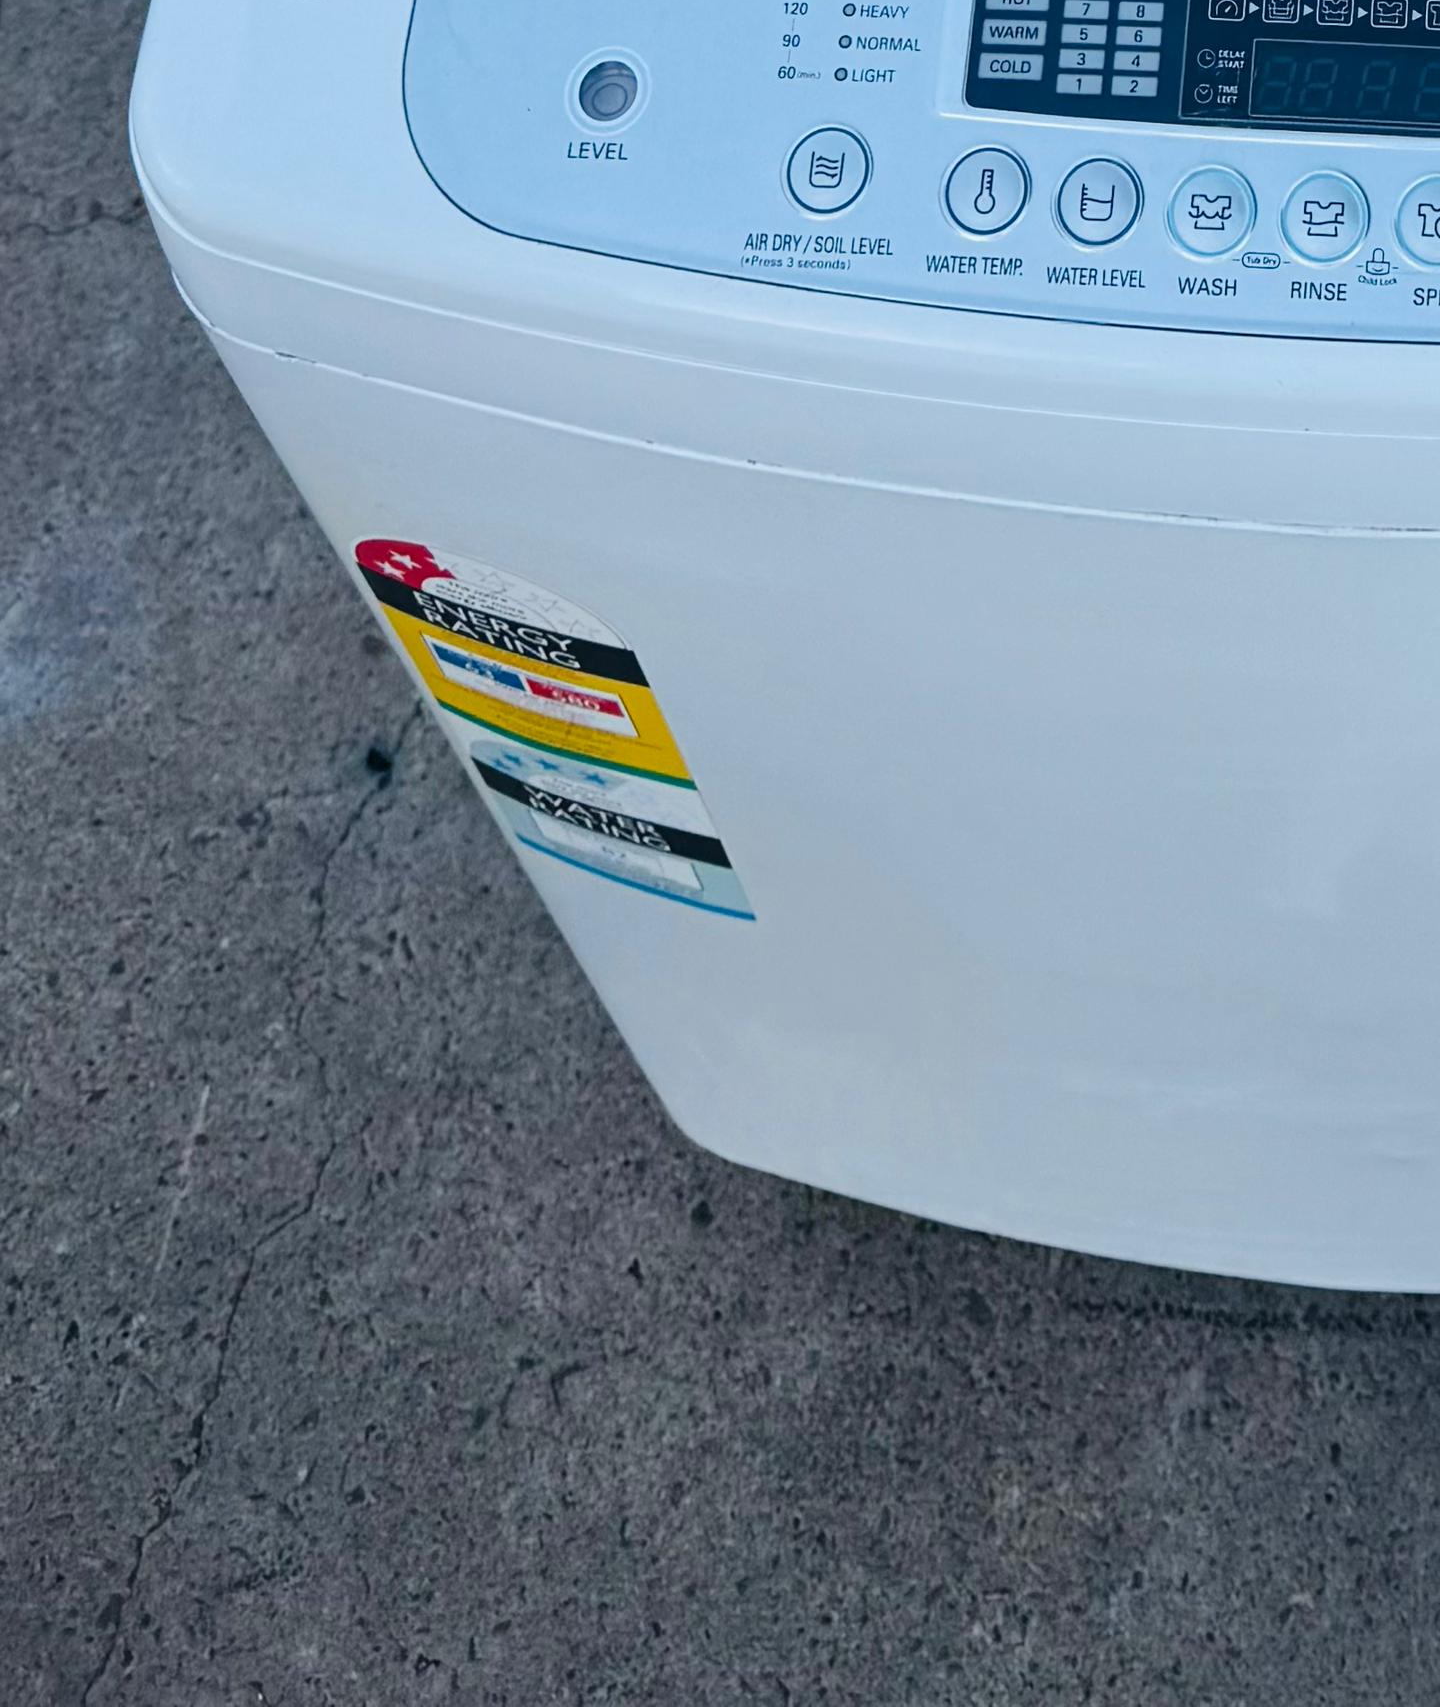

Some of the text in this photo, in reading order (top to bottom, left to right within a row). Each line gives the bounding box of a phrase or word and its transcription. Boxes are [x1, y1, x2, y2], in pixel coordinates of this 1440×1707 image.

[783, 2, 809, 16] 120
[860, 4, 909, 19] HEAVY
[1082, 3, 1091, 16] 7
[1136, 4, 1146, 18] 8
[988, 24, 1040, 41] WARM
[1079, 27, 1089, 41] 5
[1133, 29, 1143, 43] 6
[782, 34, 801, 48] 90
[855, 36, 922, 52] NORMAL
[989, 59, 1032, 74] COLD
[1076, 52, 1086, 66] 3
[1131, 54, 1141, 68] 4
[777, 65, 796, 80] 60
[851, 68, 896, 83] LIGHT
[1075, 78, 1083, 91] 1
[1128, 79, 1139, 93] 2
[567, 141, 629, 162] LEVEL
[744, 233, 768, 251] AIR
[772, 234, 803, 252] DRY
[813, 236, 847, 253] SOIL
[850, 237, 894, 255] LEVEL
[787, 257, 794, 268] 3
[925, 255, 1024, 277] WATER TEMP.
[1046, 266, 1147, 289] WATER LEVEL
[1178, 276, 1238, 297] WASH
[1290, 281, 1348, 301] RINSE
[413, 590, 574, 651] ENERGY
[424, 608, 582, 670] RATING
[523, 784, 664, 839] WATER
[529, 796, 672, 852] RATING
